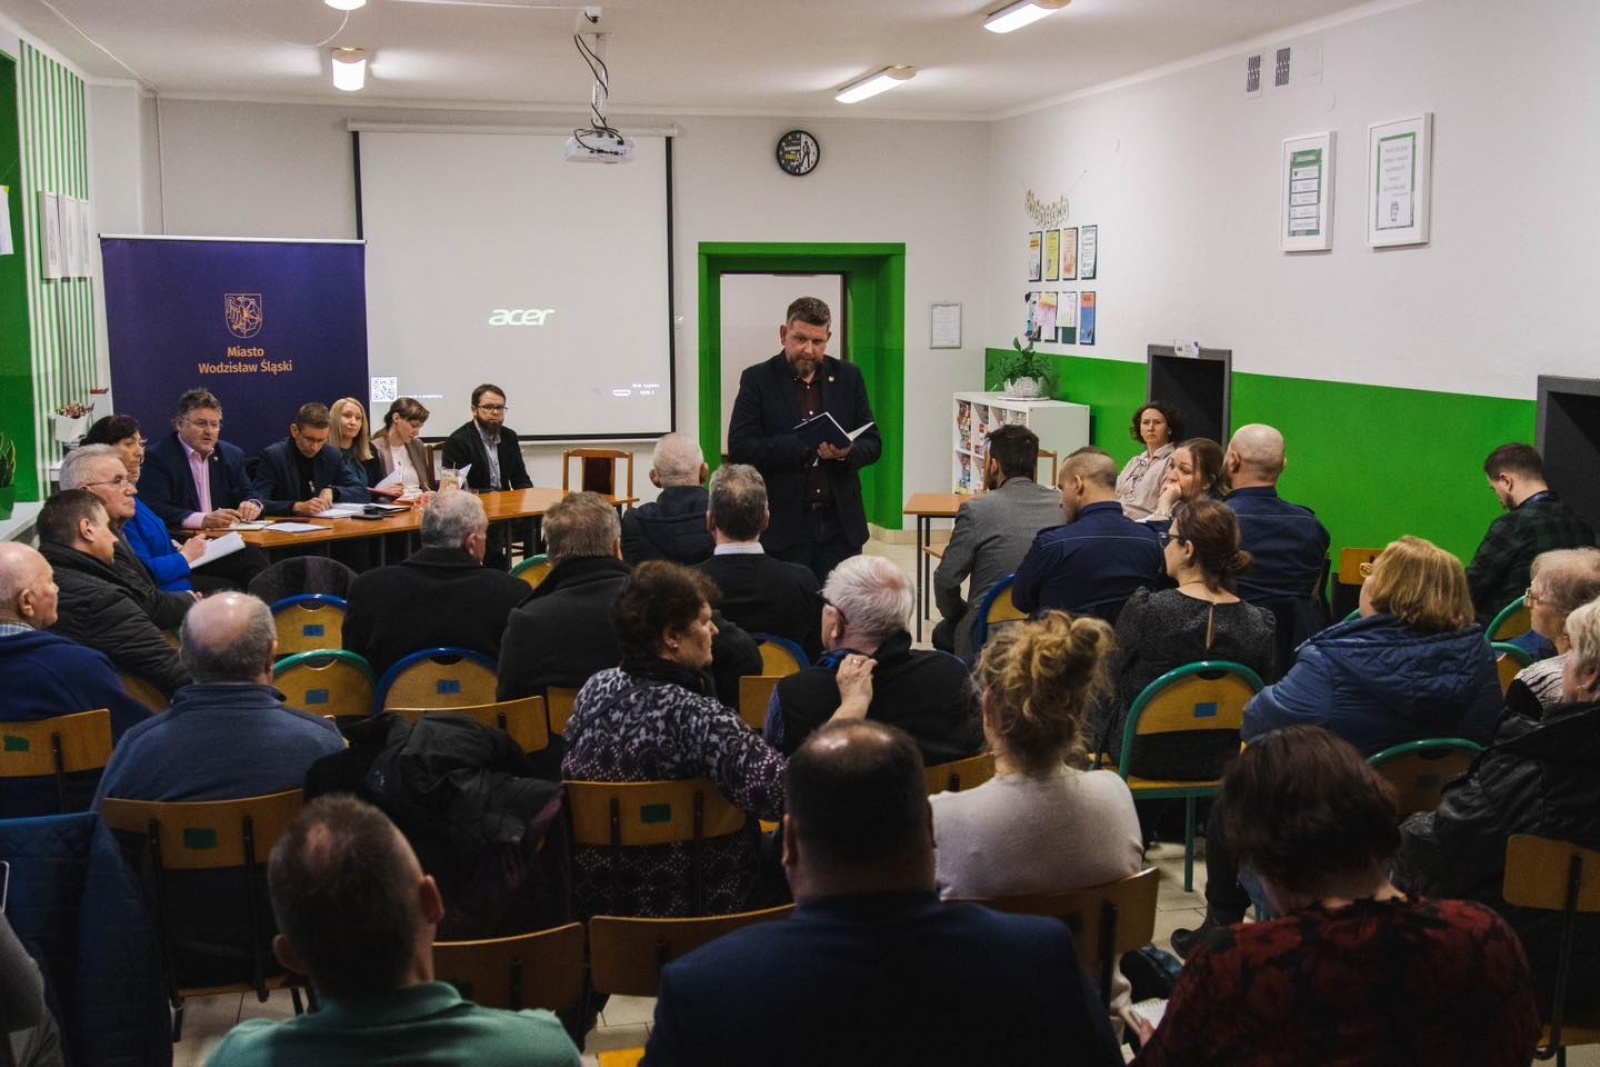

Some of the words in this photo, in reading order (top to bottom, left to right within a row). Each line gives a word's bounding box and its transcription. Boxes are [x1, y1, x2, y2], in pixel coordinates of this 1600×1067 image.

[489, 309, 555, 325] acer
[227, 345, 265, 357] Miasto
[198, 361, 258, 374] Wodzisław
[260, 358, 293, 375] Śląski
